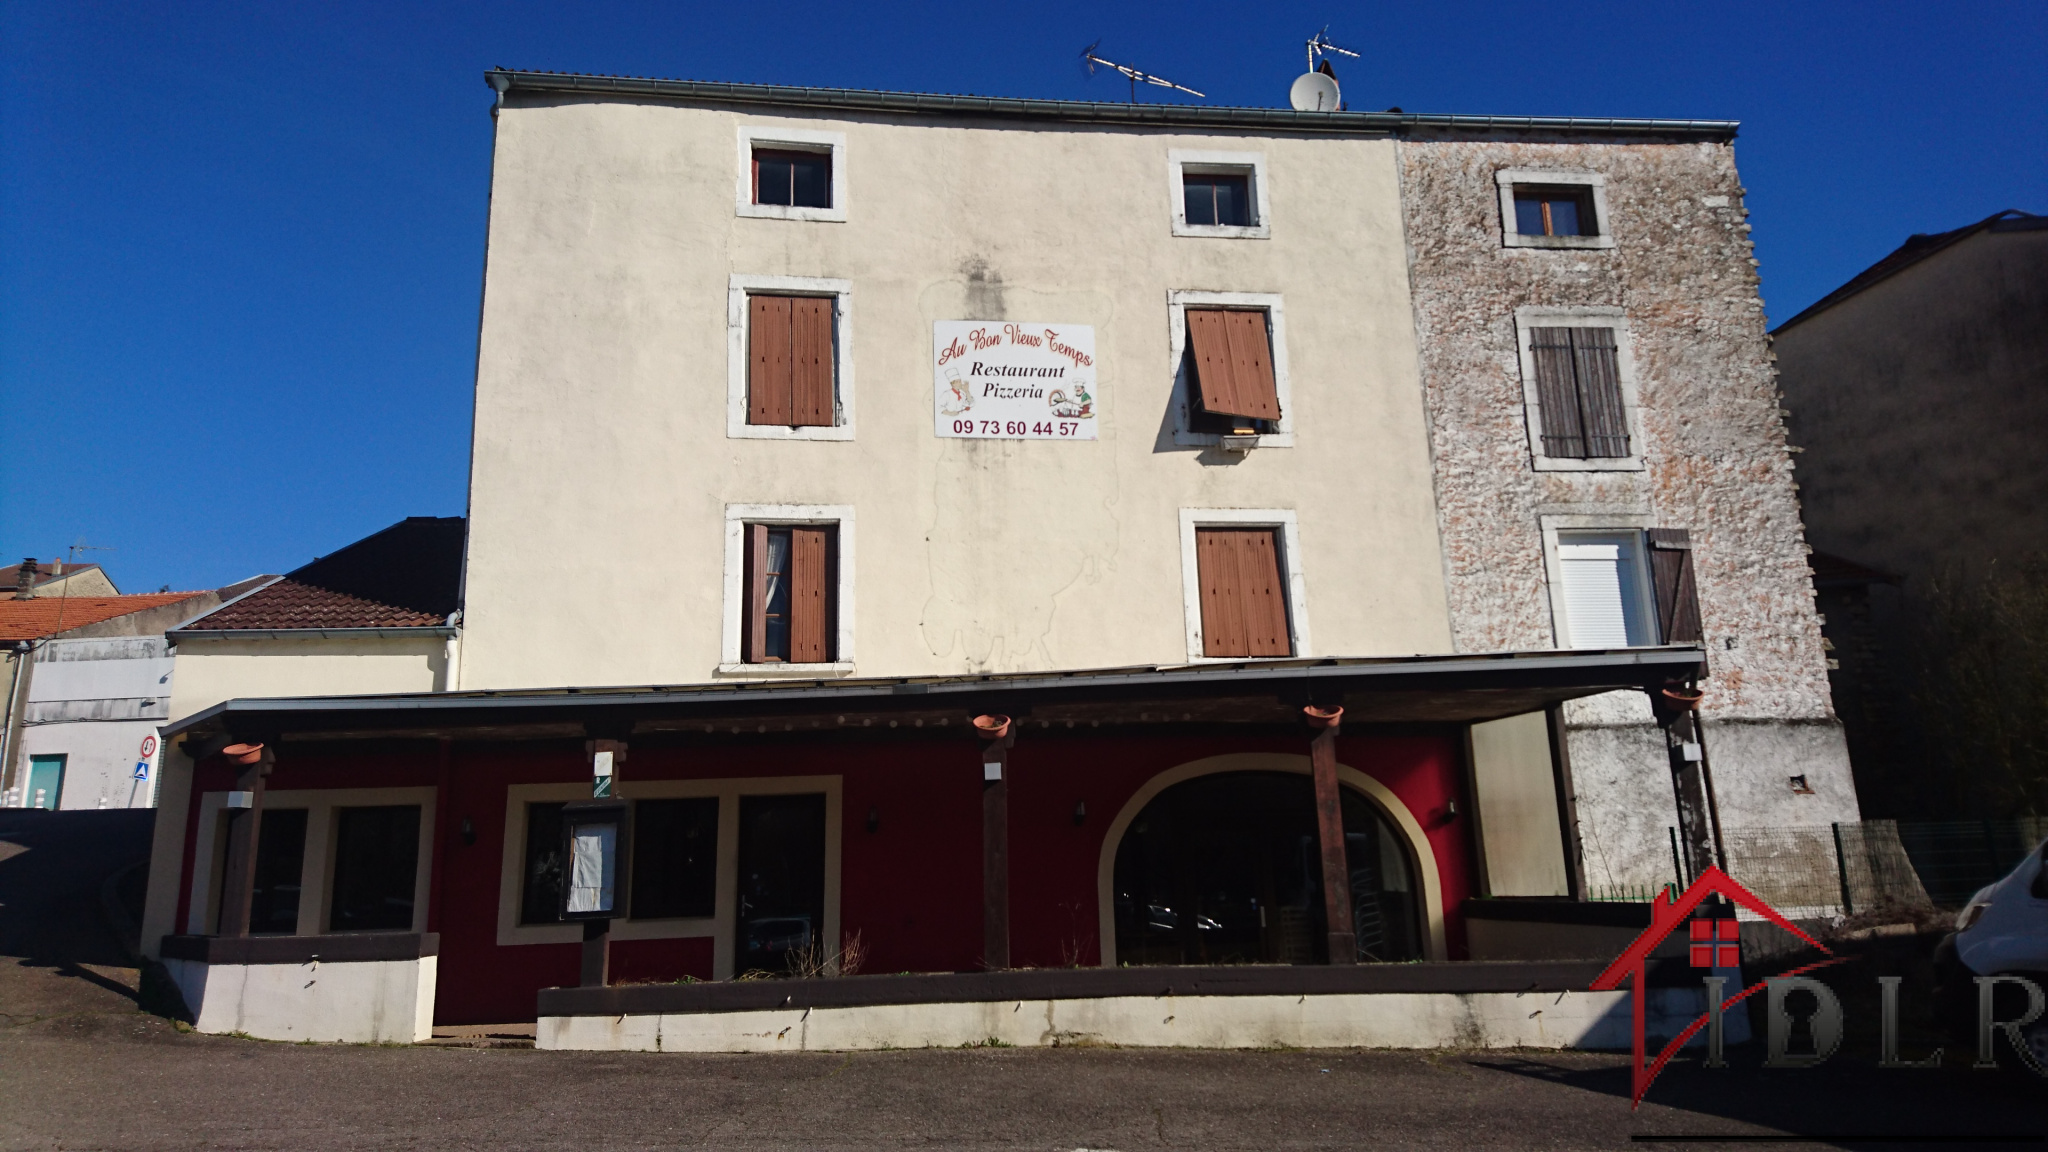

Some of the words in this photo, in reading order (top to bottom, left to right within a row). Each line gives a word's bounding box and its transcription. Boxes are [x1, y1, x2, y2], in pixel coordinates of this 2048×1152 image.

[938, 336, 967, 366] Au
[969, 327, 1002, 351] Bon
[1003, 323, 1043, 348] Vieux
[1044, 328, 1094, 368] Temps
[970, 361, 1066, 378] Restaurant
[982, 382, 1044, 399] Pizzeria
[953, 419, 974, 434] 09
[979, 420, 1000, 435] 73
[1006, 421, 1027, 435] 60
[1032, 421, 1053, 436] 44
[1059, 422, 1079, 436] 57
